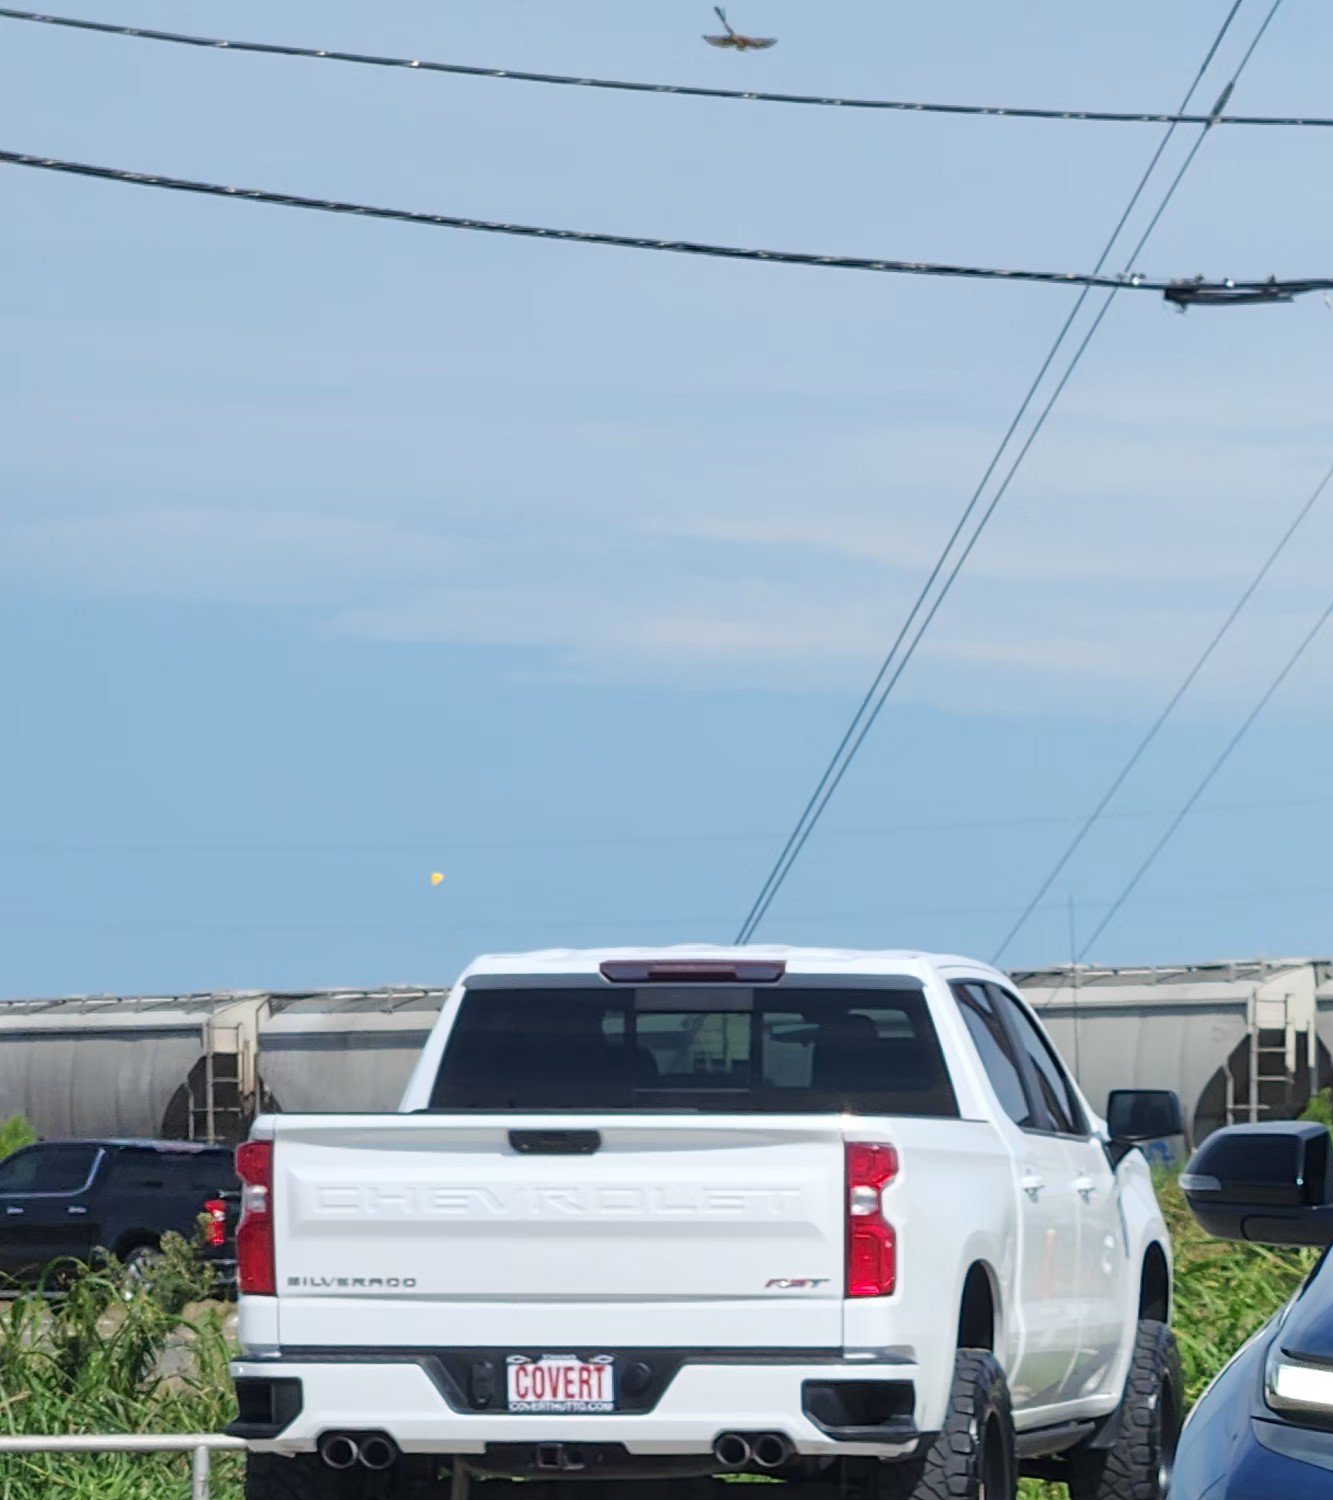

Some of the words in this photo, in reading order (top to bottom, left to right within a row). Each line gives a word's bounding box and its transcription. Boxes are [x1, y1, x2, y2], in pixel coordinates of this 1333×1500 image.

[312, 1186, 801, 1215] CHEVROLET
[287, 1276, 417, 1288] SILVERADO
[515, 1364, 606, 1400] COVERT
